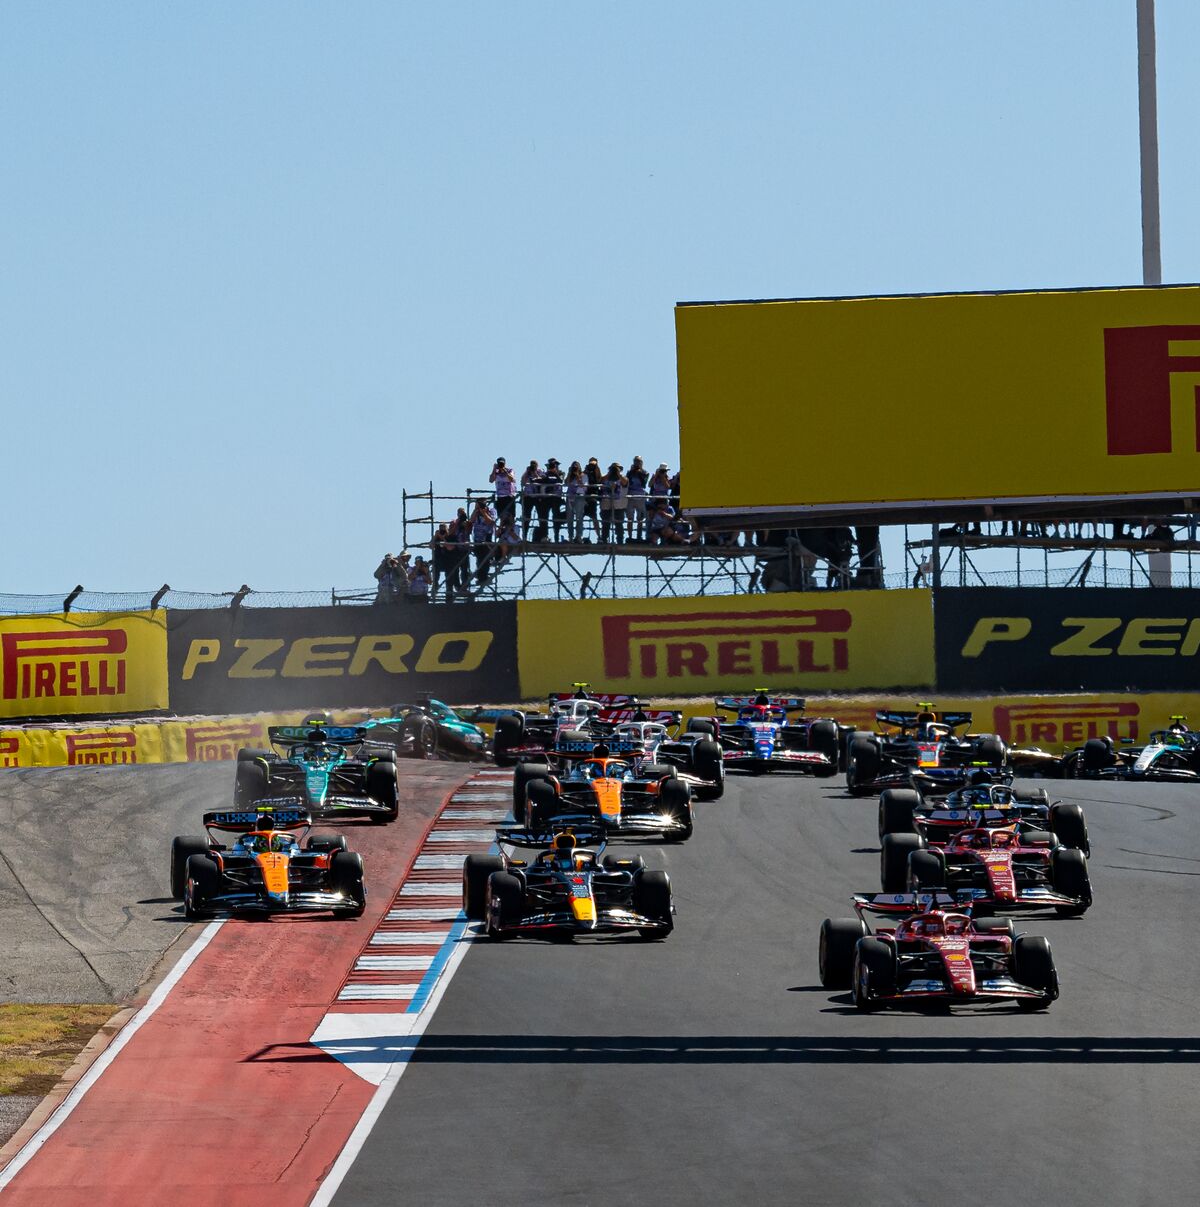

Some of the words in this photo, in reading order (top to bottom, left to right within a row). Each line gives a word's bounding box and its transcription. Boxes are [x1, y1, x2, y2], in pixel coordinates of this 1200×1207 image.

[181, 638, 220, 681] P
[227, 629, 495, 679] ZERO
[602, 608, 852, 679] PIRELLI
[960, 616, 1031, 658] P
[2, 628, 127, 700] PIRELLI
[186, 723, 263, 761] PIREL
[283, 727, 352, 737] araco
[993, 702, 1140, 744] PIRELLI
